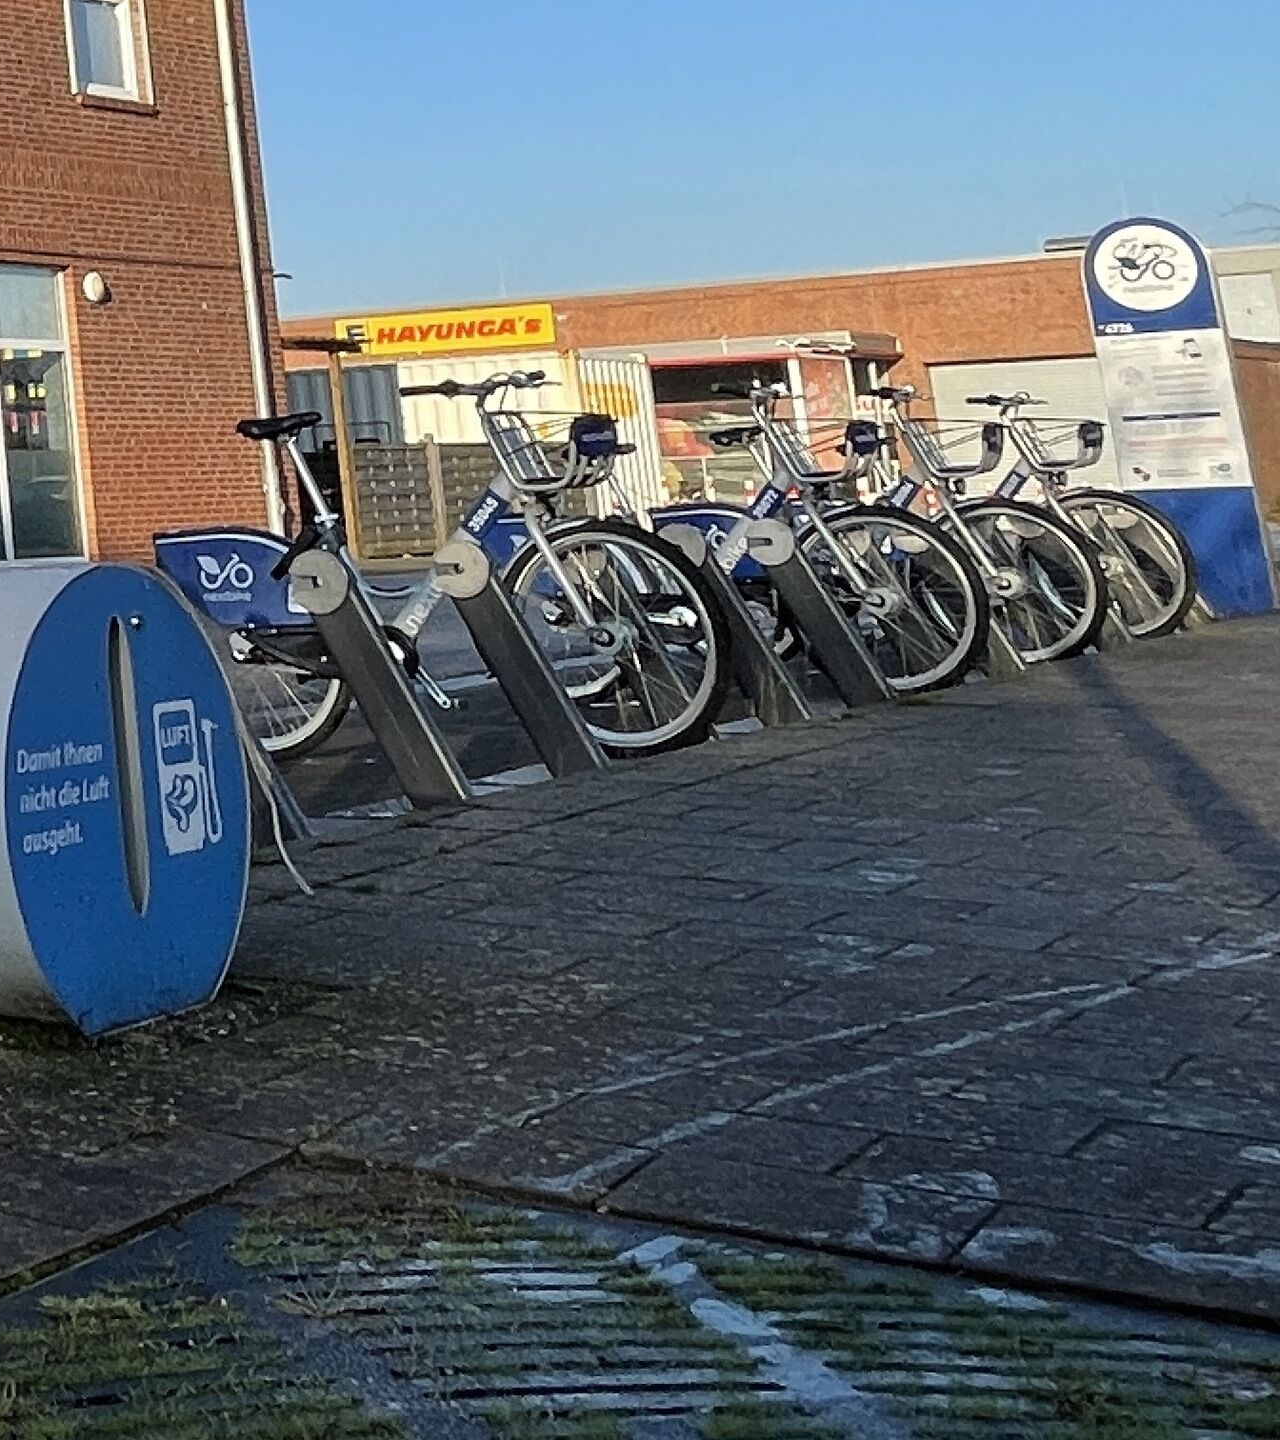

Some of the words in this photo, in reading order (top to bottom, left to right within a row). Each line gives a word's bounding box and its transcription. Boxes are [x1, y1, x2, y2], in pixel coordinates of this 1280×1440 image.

[376, 315, 542, 345] HAYUNGA's
[161, 724, 190, 748] LUFT
[17, 743, 61, 773] Damit
[64, 741, 103, 766] Ihnen
[20, 784, 56, 813] nicht
[59, 779, 80, 807] die
[82, 774, 110, 803] Luft
[23, 819, 84, 855] ausgeht.
